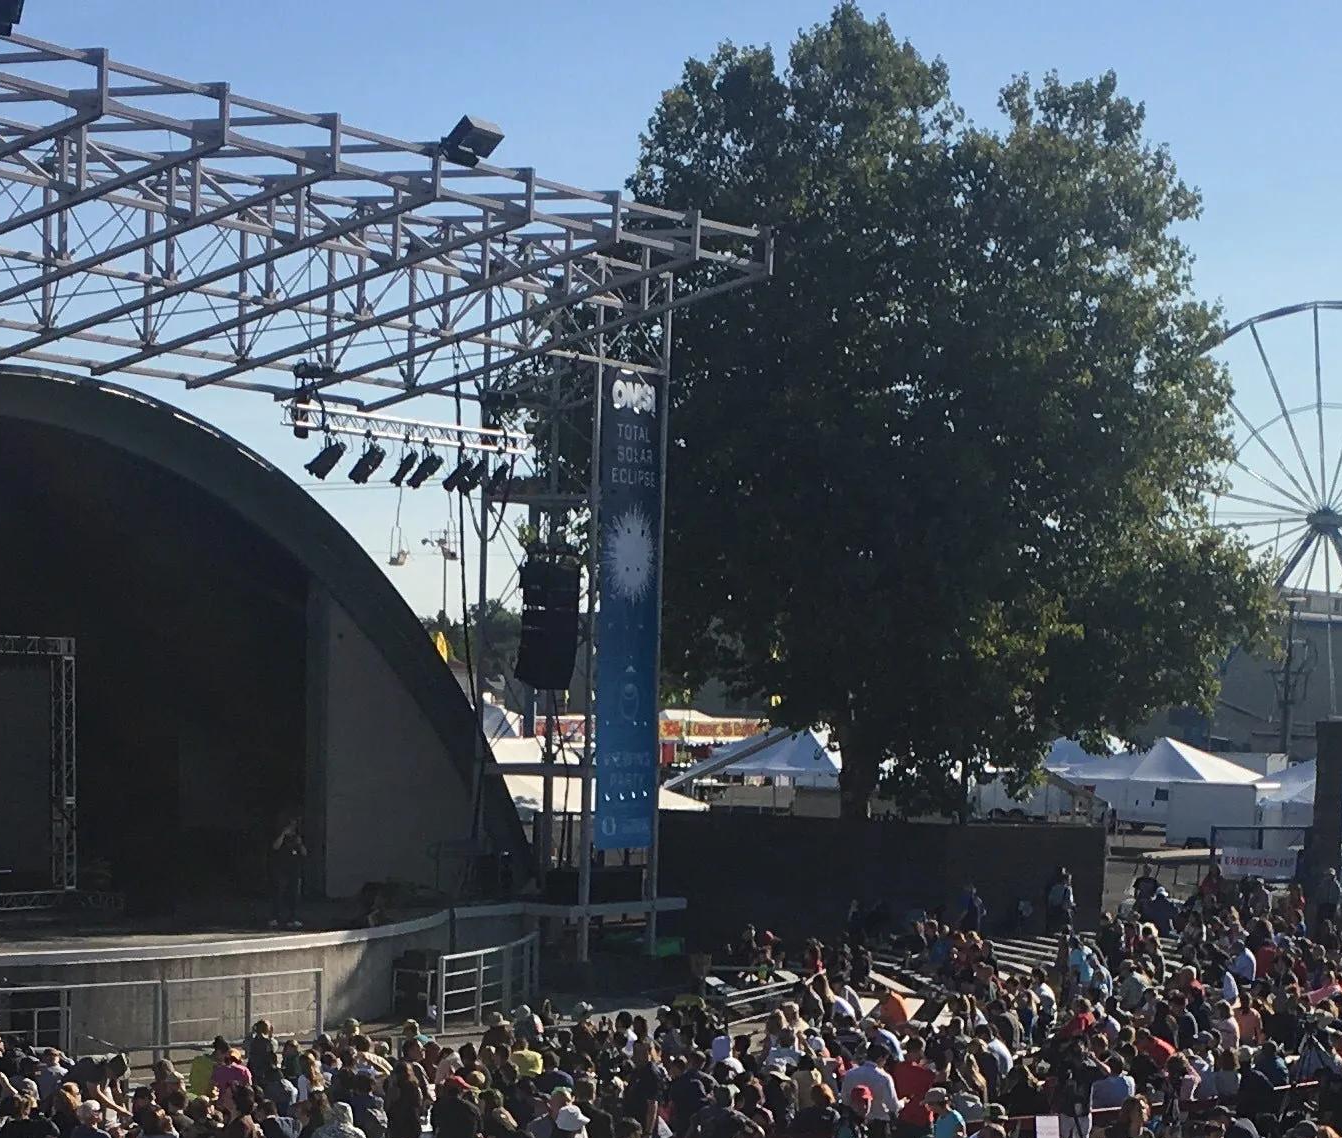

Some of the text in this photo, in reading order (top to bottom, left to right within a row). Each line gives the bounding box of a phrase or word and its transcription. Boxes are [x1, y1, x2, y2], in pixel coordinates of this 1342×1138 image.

[617, 423, 651, 443] TOTAL
[617, 447, 653, 464] SOLAR
[611, 467, 656, 488] ECLIPSE
